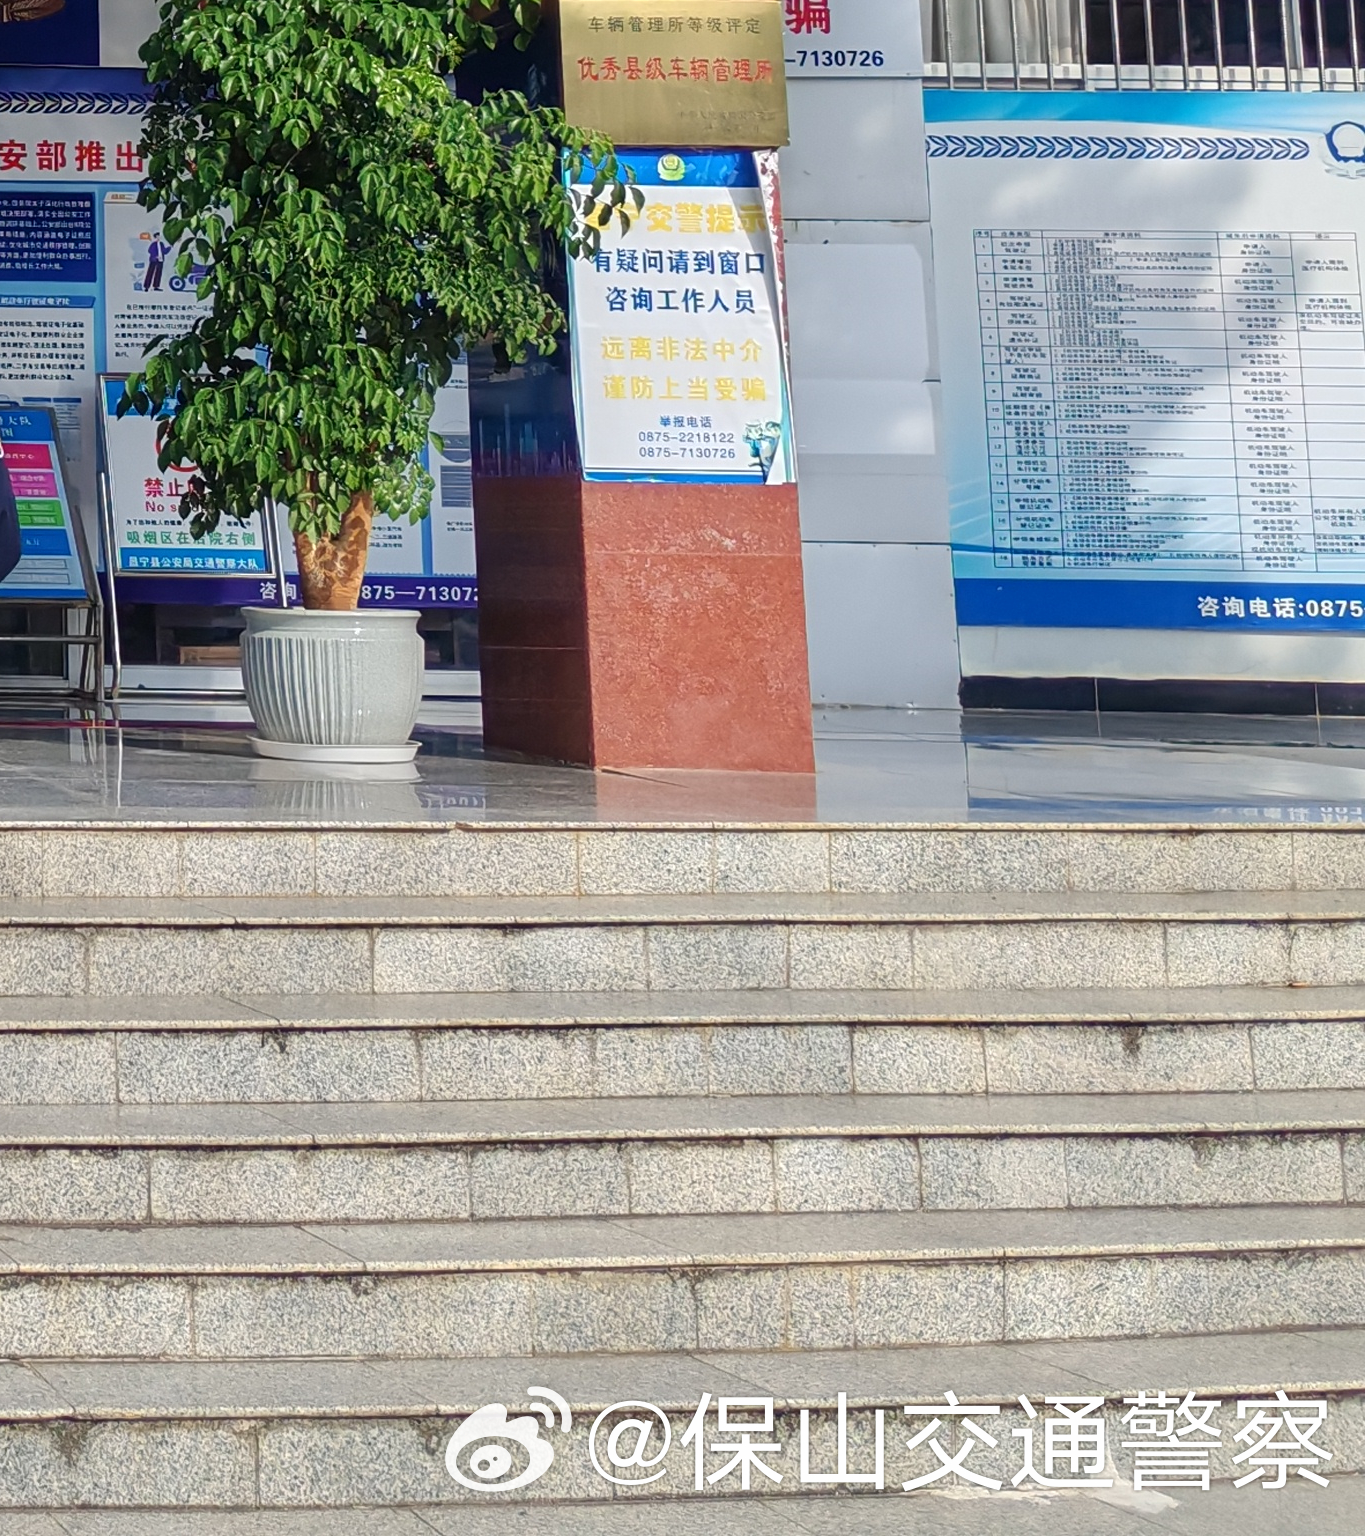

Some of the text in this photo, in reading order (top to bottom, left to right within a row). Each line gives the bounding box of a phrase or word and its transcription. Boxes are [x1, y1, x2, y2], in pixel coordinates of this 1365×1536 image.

[588, 17, 761, 34] 车辆管理所等级评定
[577, 56, 773, 83] 优秀县级车辆管理所
[594, 249, 766, 275] 有疑问请到窗口
[606, 287, 756, 313] 咨询工作人员
[601, 336, 763, 362] 远离非法中介
[603, 376, 767, 402] 谨防上当受骗
[659, 415, 713, 428] 举报电话
[638, 431, 735, 444] 0875-2218122
[639, 447, 736, 459] 0875-7130726
[146, 502, 163, 512] No
[129, 556, 258, 569] 昌宁县公安局交通警察大队
